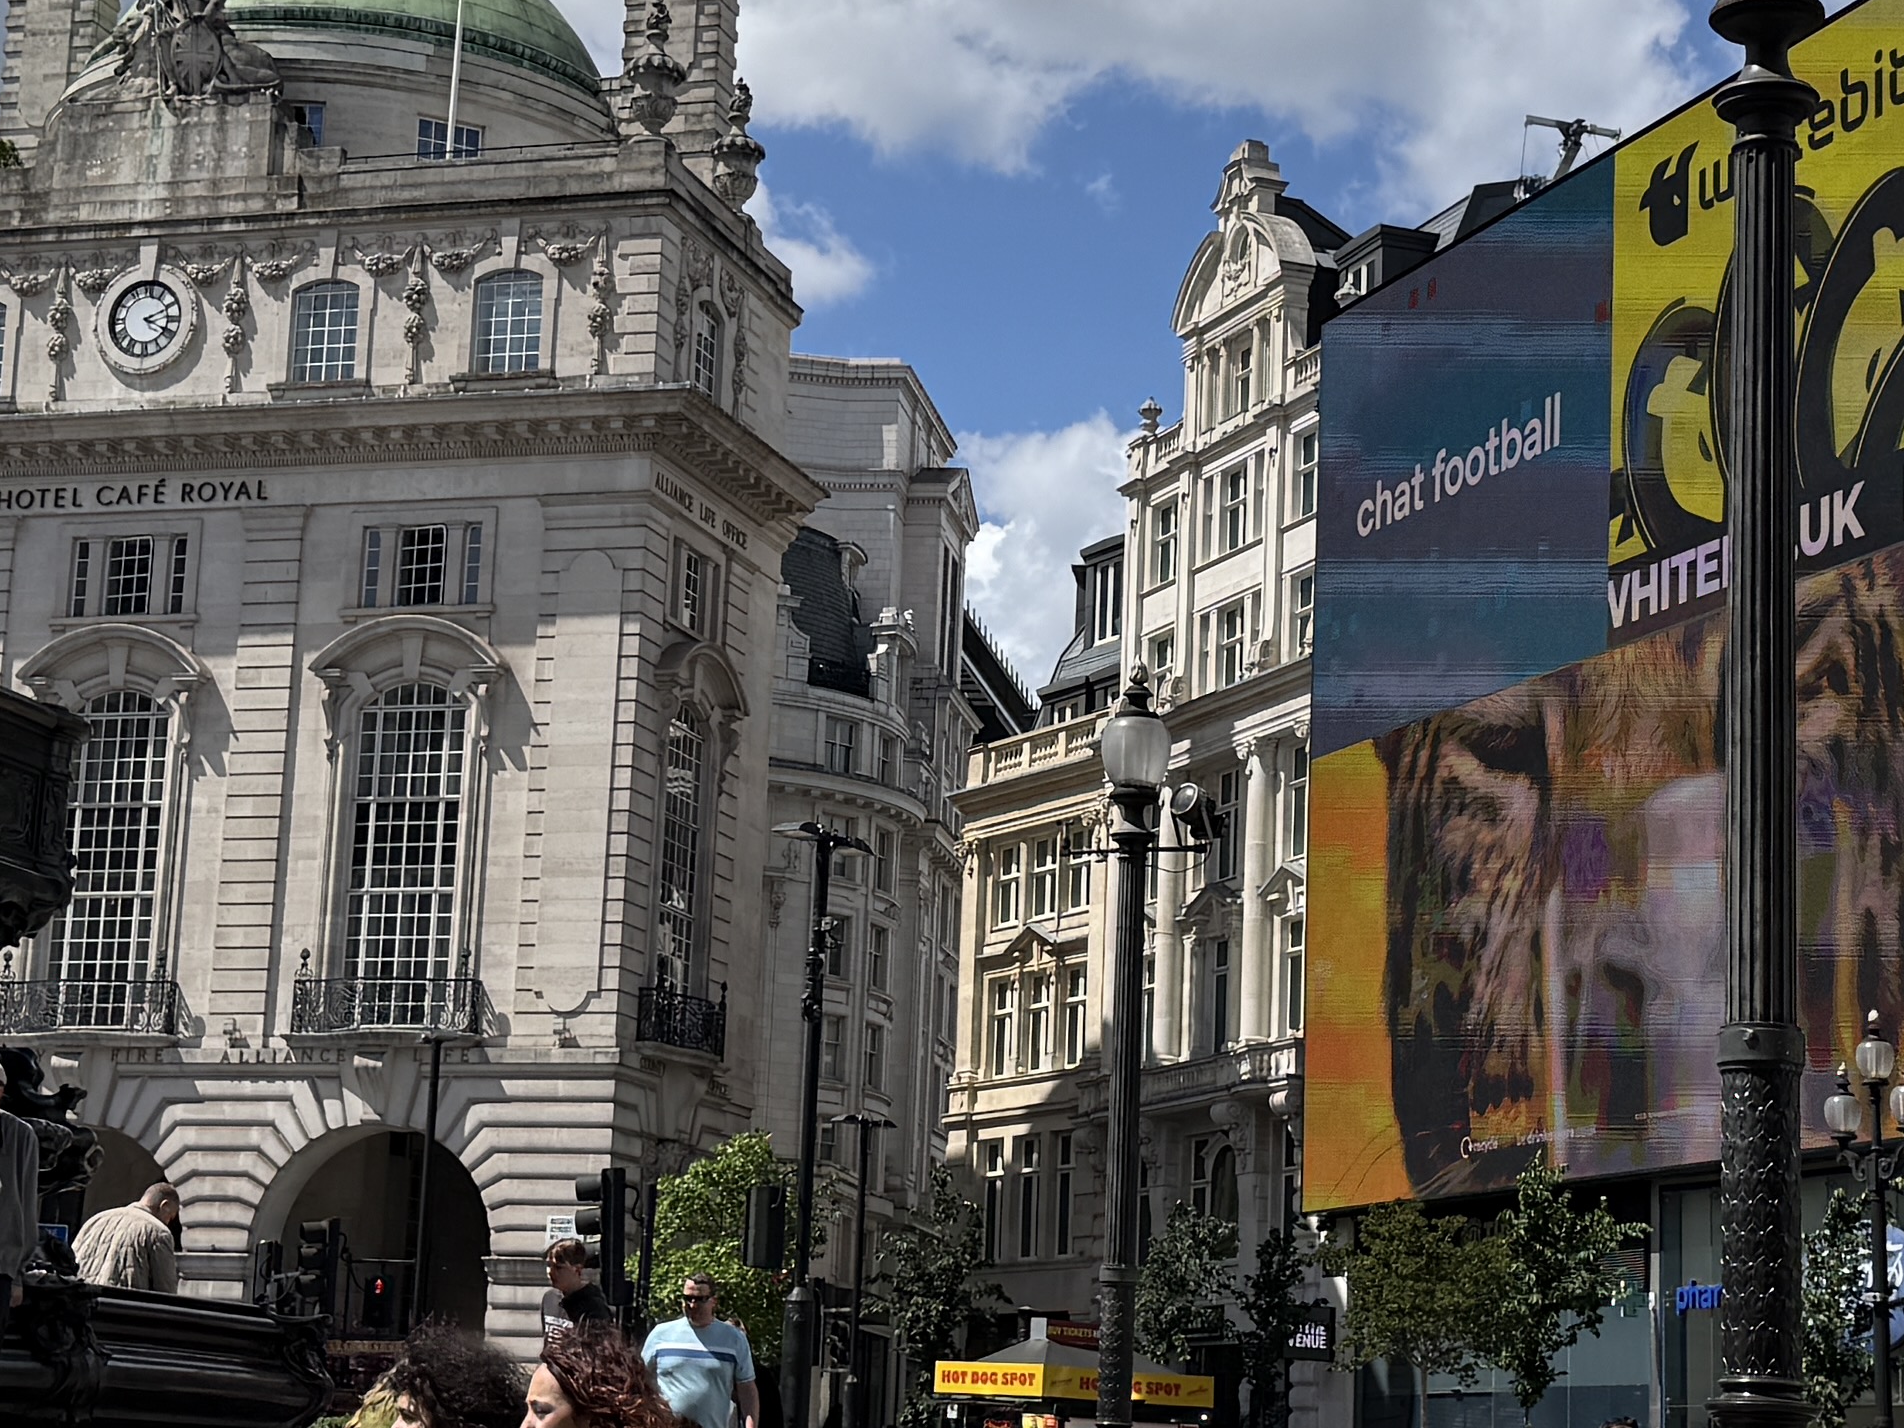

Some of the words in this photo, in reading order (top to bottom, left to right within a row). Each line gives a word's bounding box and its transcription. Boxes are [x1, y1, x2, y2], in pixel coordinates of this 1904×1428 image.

[1357, 463, 1424, 537] chat
[1432, 391, 1561, 503] football
[96, 478, 167, 507] CAFÉ
[180, 479, 269, 504] ROYAL
[655, 471, 694, 513] ALLIANCE
[699, 502, 716, 529] LIFE
[722, 519, 748, 550] OFFICE
[220, 1048, 347, 1064] ALLIANCE
[414, 1047, 470, 1063] LFE
[941, 1369, 968, 1385] HOT
[971, 1370, 998, 1386] DOG
[1001, 1371, 1036, 1387] SPOT
[1145, 1381, 1182, 1397] SPOT
